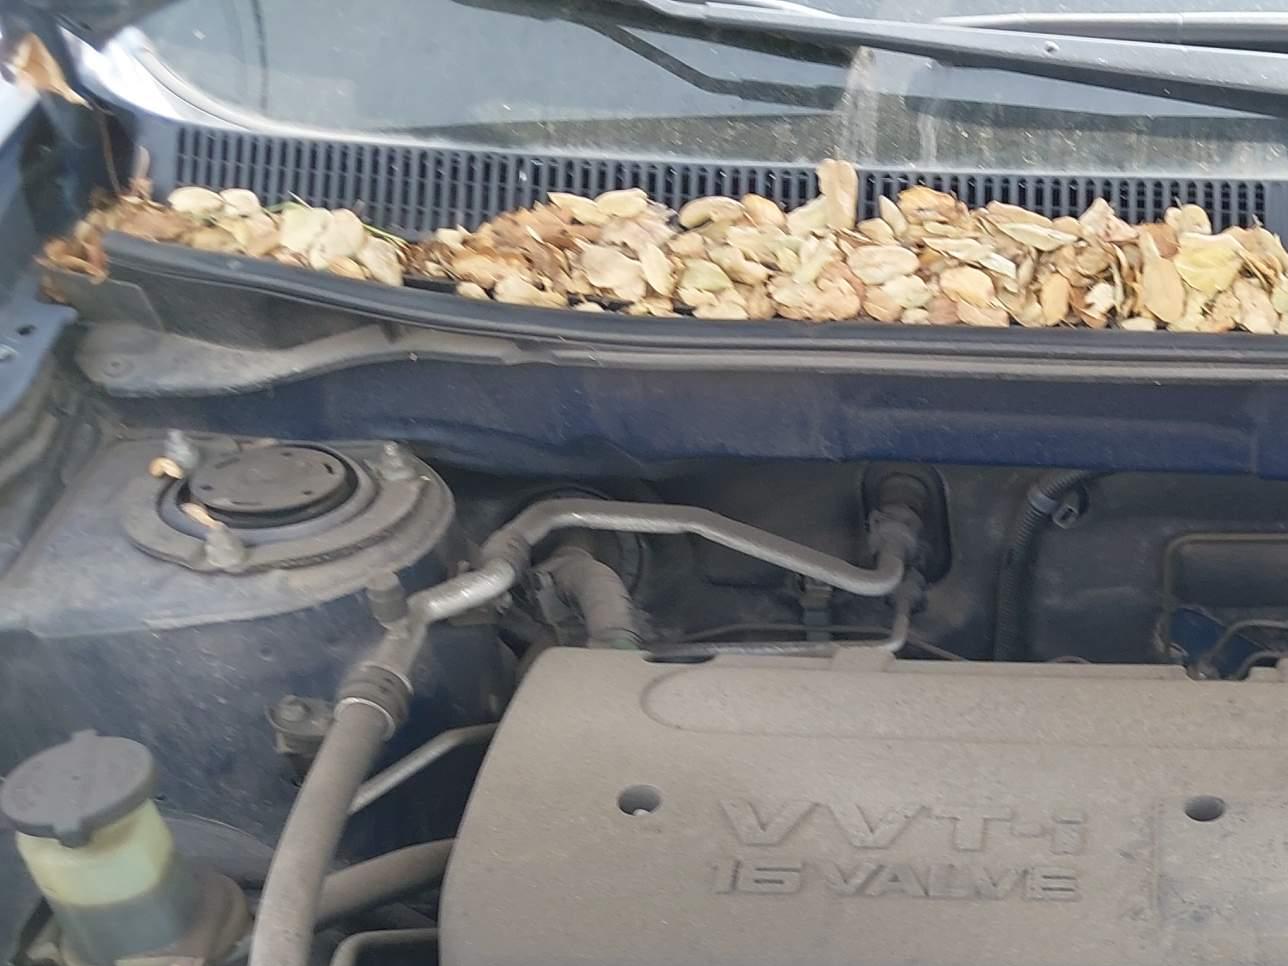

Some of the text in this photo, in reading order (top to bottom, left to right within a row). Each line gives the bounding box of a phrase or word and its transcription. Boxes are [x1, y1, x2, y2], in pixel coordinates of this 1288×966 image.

[719, 800, 1088, 854] VVT-i
[712, 861, 1081, 902] 16 VALVE
